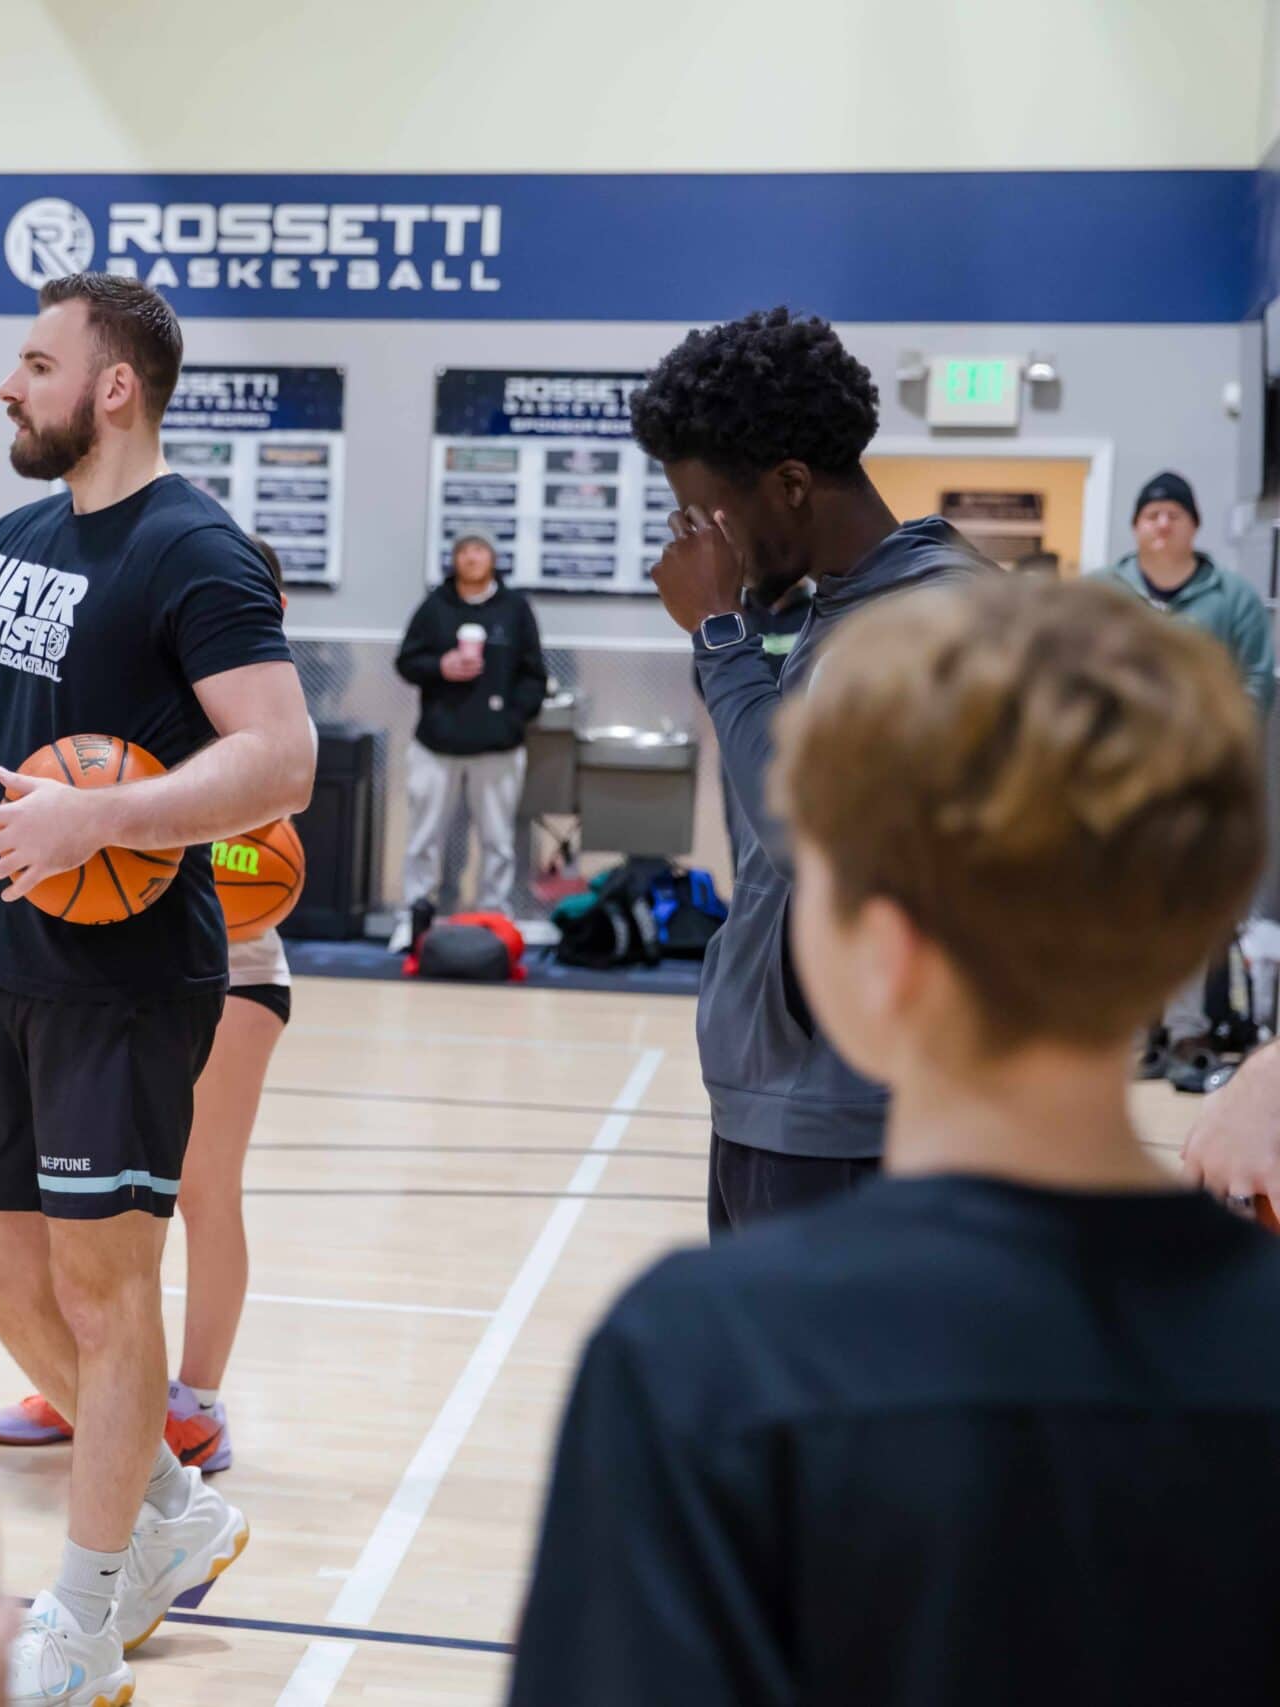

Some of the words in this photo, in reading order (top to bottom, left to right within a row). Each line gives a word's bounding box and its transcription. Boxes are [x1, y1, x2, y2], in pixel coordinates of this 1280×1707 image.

[109, 203, 501, 256] ROSSETTI
[504, 378, 648, 403] ROSSET
[946, 361, 1005, 403] EXIT
[40, 1155, 91, 1171] NEPTUNE
